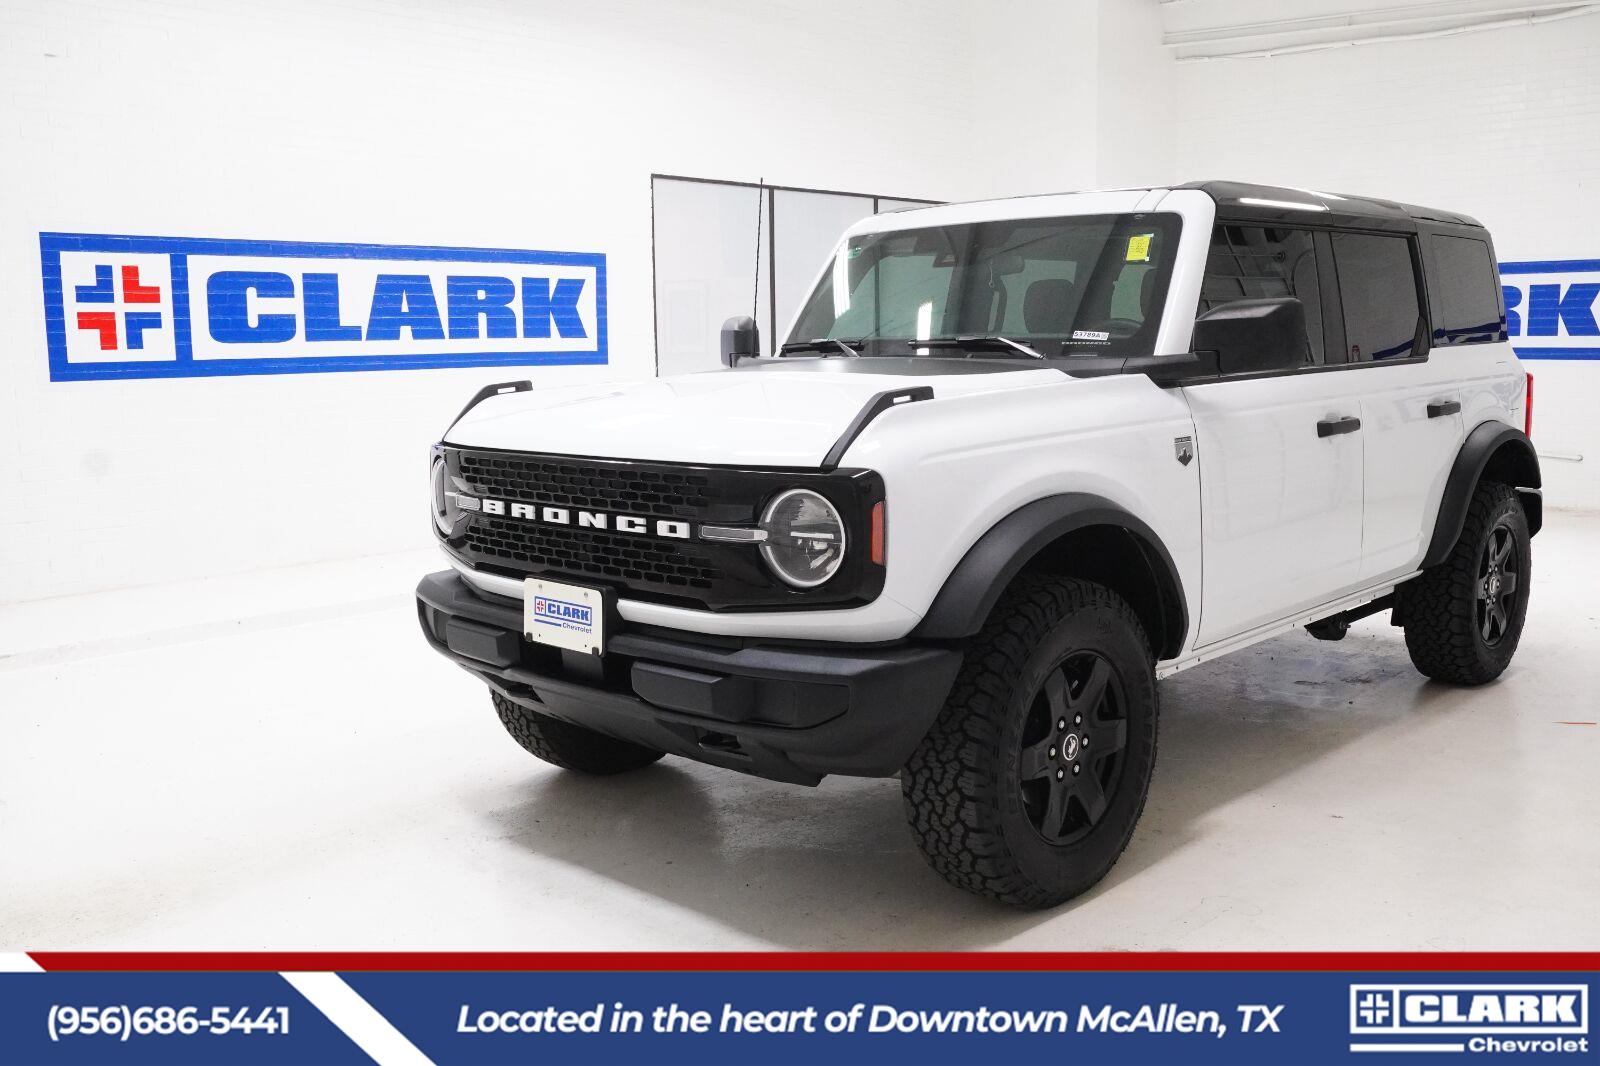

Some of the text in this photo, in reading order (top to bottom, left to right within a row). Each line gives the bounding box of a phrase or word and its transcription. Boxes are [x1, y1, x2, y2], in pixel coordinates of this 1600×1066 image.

[206, 270, 588, 344] CLARK
[1501, 283, 1600, 337] K
[483, 499, 691, 539] BRONCO
[547, 602, 589, 621] CLARK
[562, 622, 592, 634] Chevrolet
